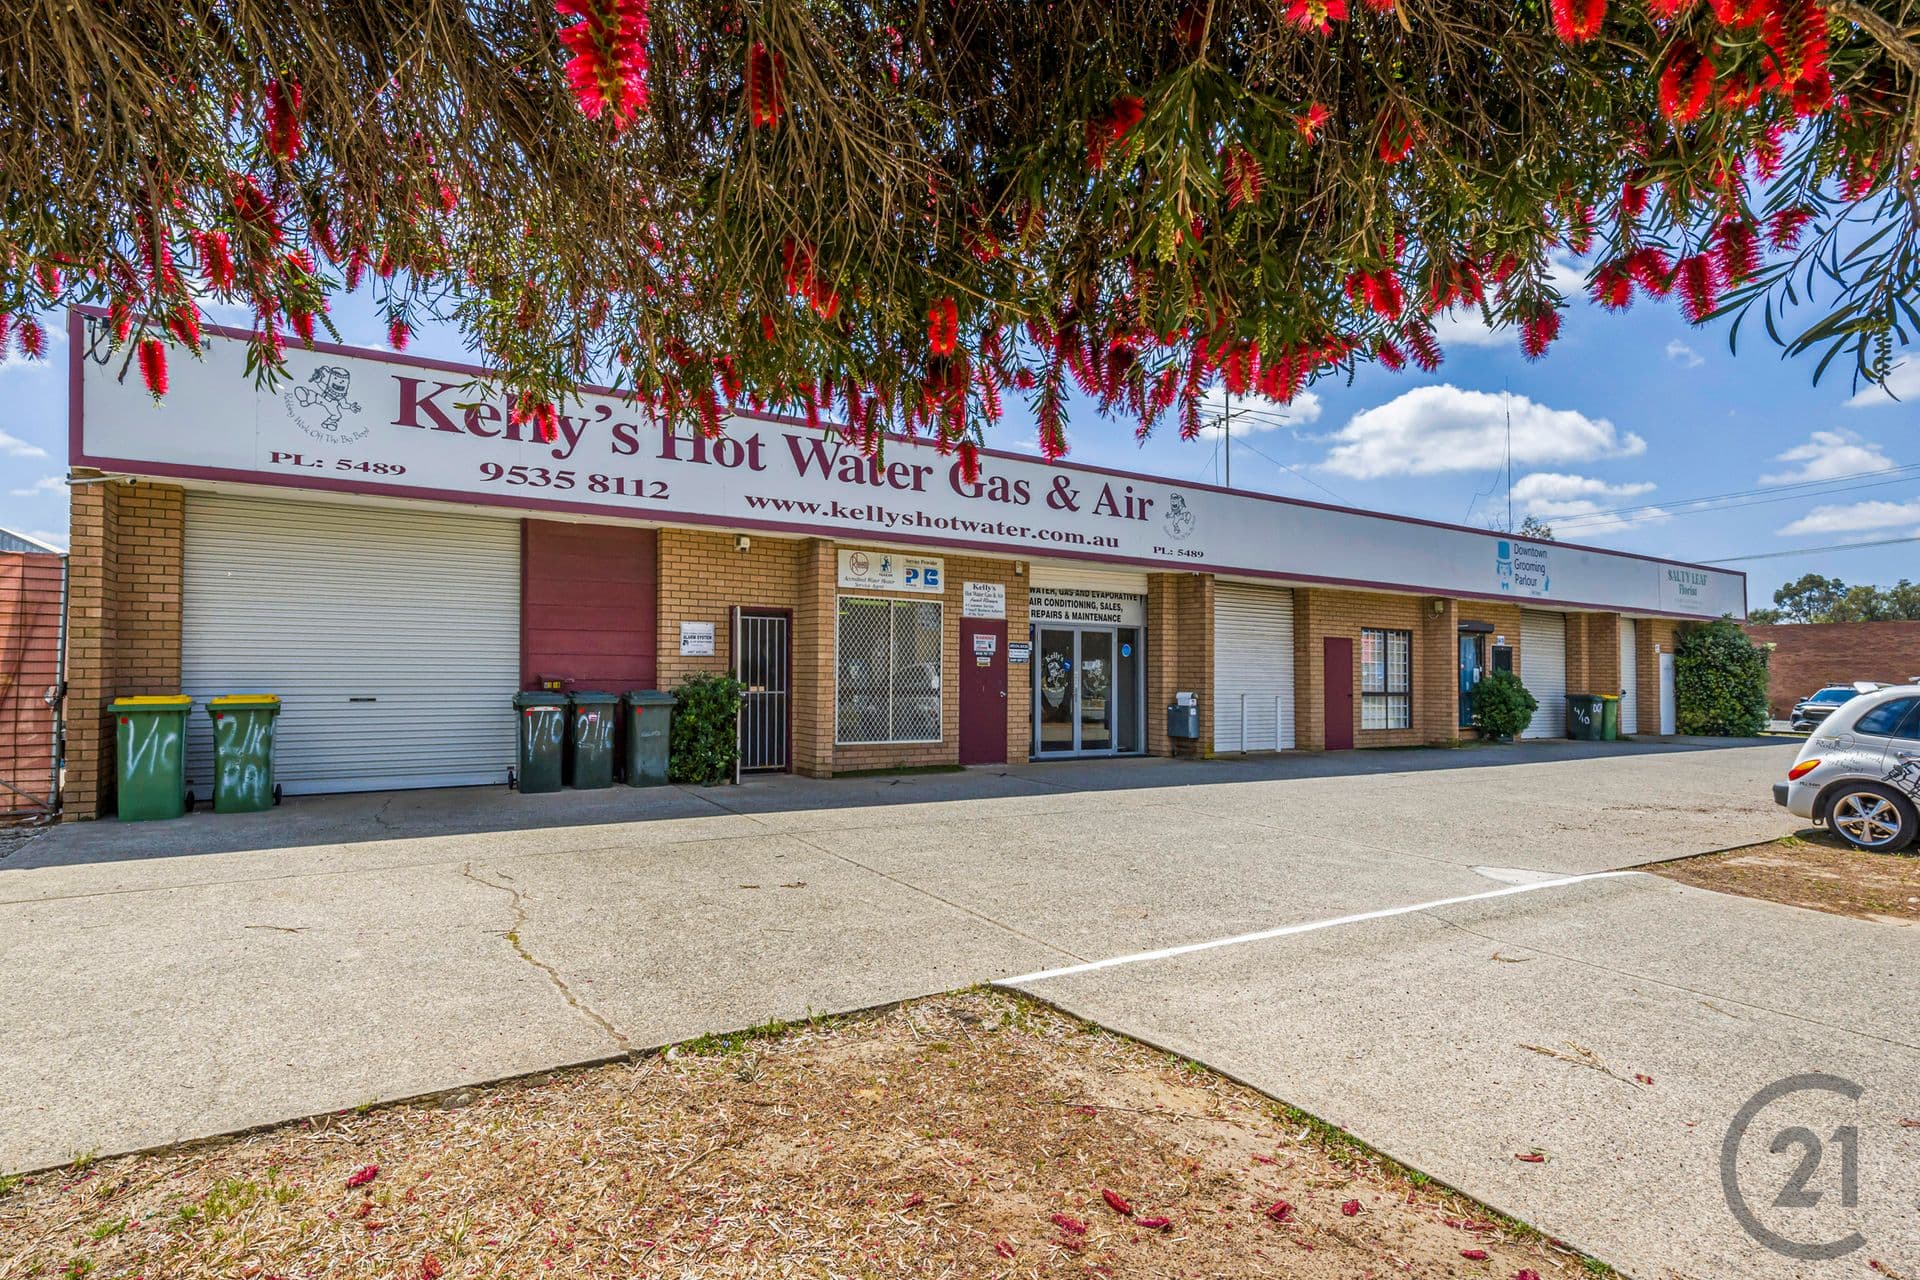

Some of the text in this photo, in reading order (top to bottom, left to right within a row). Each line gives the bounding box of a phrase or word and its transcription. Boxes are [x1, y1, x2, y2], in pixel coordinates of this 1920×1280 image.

[269, 452, 406, 476] PL: 5489
[656, 412, 767, 471] Hot
[949, 457, 1031, 506] Gas
[1046, 474, 1080, 512] &
[1092, 482, 1154, 521] Air
[479, 462, 670, 500] 9535 8112
[745, 495, 1120, 548] www.kellyshotwater.com.au
[1153, 546, 1204, 558] PL: 5489
[1514, 543, 1548, 558] Downtown
[1514, 558, 1546, 576] Grooming
[1514, 573, 1538, 587] Parlour
[1668, 569, 1690, 583] SALTY
[972, 583, 997, 593] Kelly's
[1091, 590, 1138, 602] EVAPORATIVE
[1029, 597, 1124, 613] AIR CONDITIONING, SALES,
[1030, 609, 1063, 620] REPAIRS
[1071, 611, 1122, 622] MAINTENANCE
